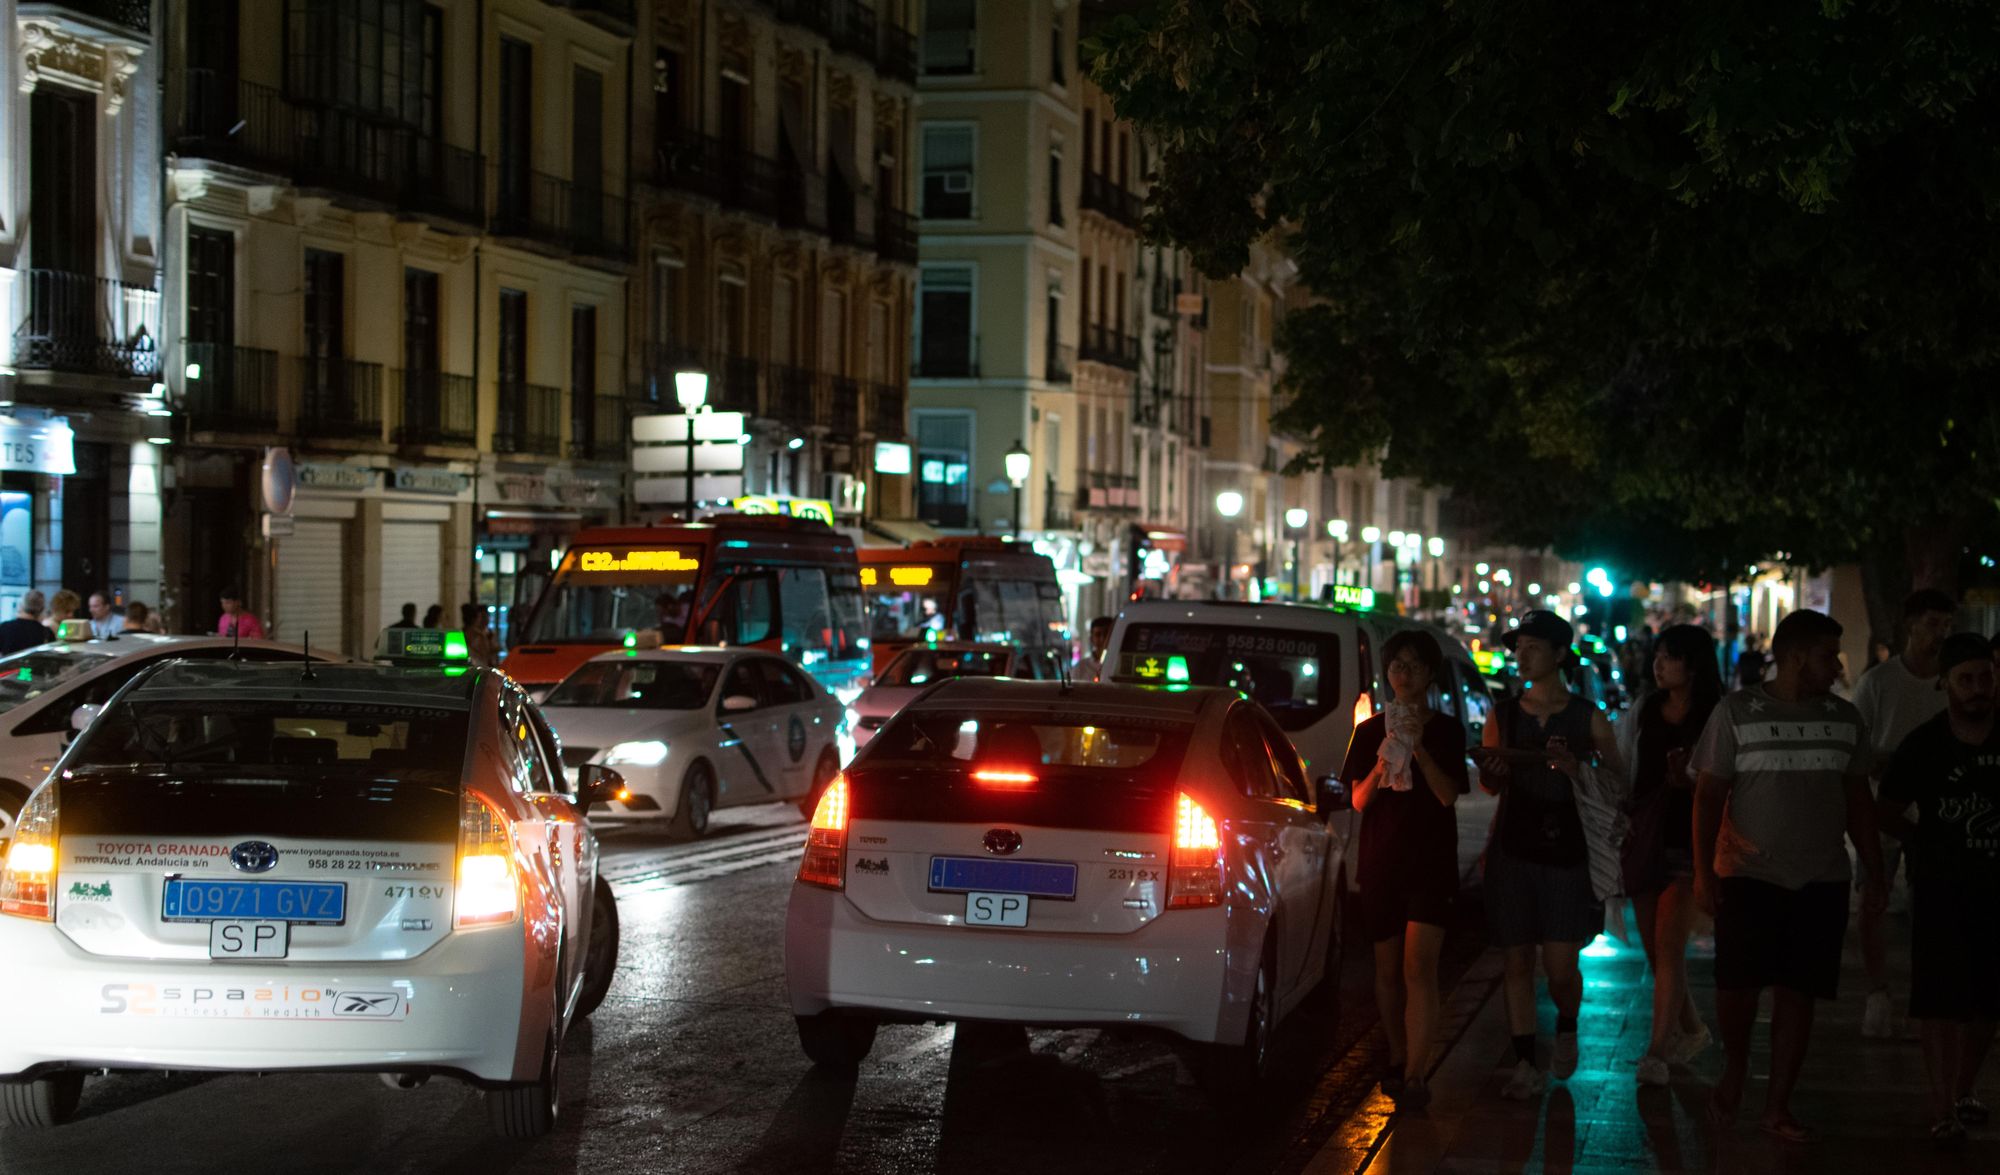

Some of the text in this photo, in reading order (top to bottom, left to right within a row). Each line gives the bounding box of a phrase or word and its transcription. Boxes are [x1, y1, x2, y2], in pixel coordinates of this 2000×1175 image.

[1334, 585, 1361, 604] TAXI
[1227, 634, 1255, 649] 958
[1256, 637, 1275, 651] 28
[1276, 639, 1296, 653] 00
[97, 842, 231, 857] TOYOTA GRANADA
[279, 848, 400, 858] www.toyotagranada.toyota.es
[192, 858, 209, 868] s/n
[308, 859, 328, 869] 958
[331, 860, 345, 869] 28
[348, 860, 361, 870] 22
[1109, 868, 1135, 880] 231
[384, 886, 414, 898] 471
[187, 886, 336, 915] 0971 GVZ
[325, 988, 337, 998] By
[263, 1008, 321, 1017] Health
